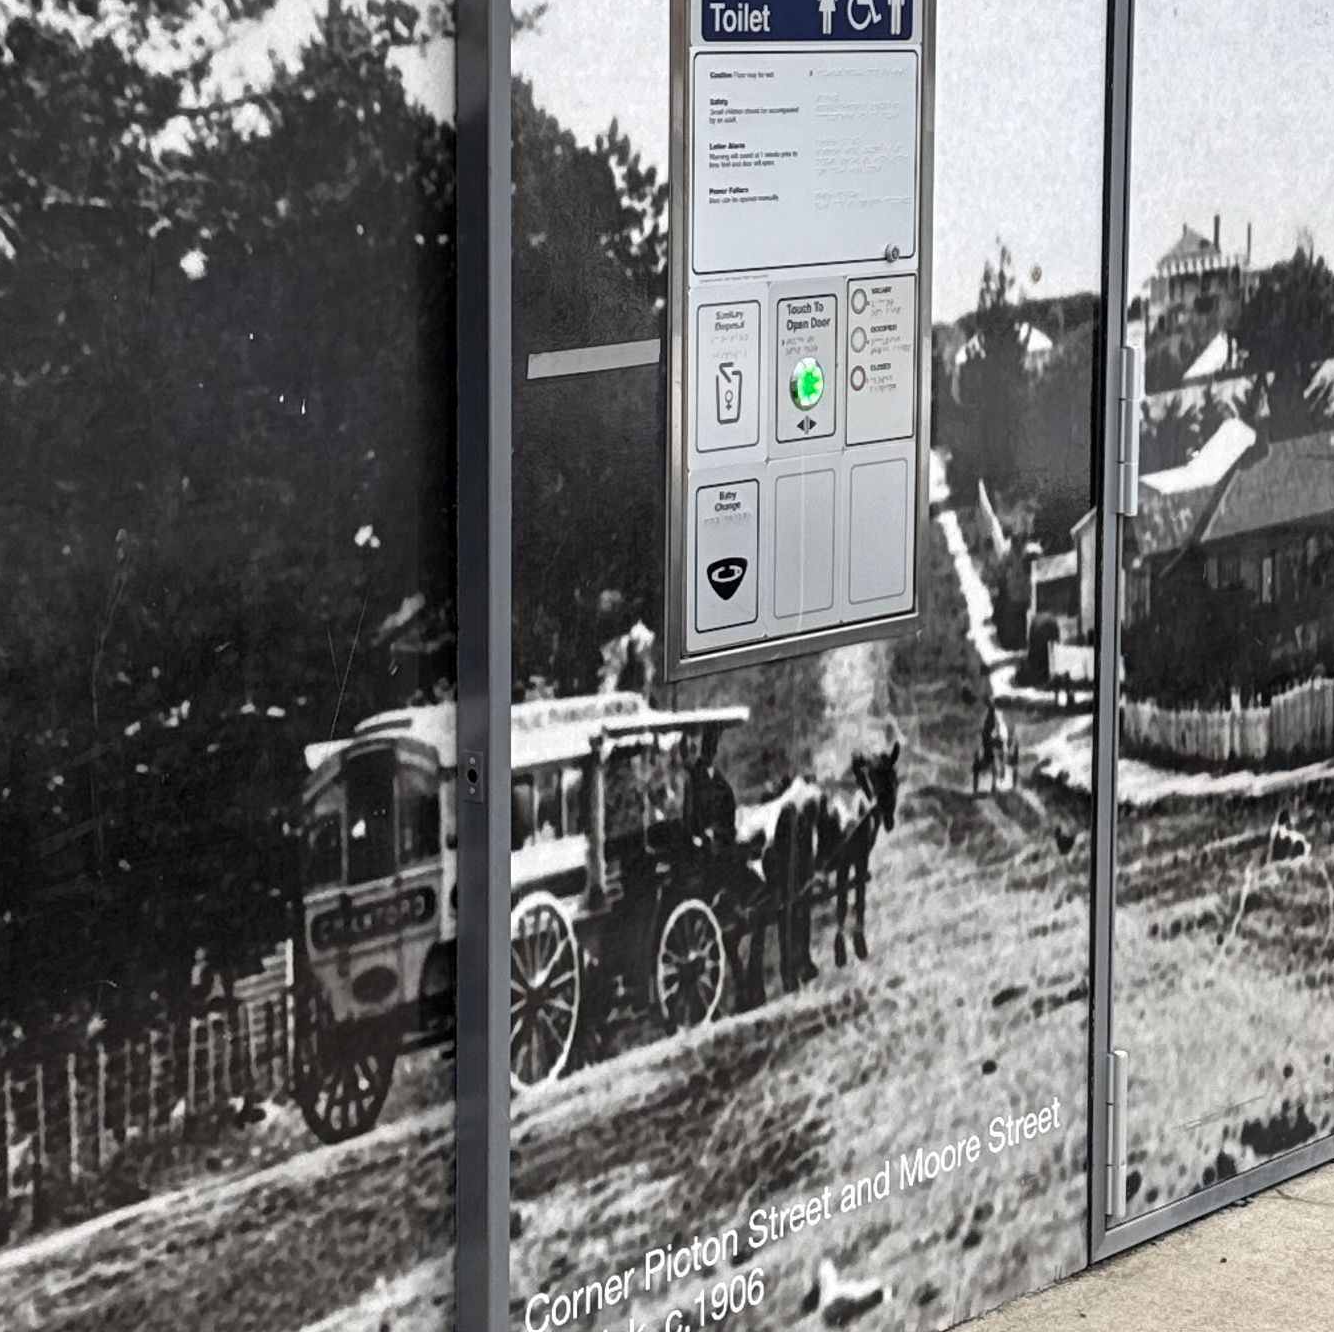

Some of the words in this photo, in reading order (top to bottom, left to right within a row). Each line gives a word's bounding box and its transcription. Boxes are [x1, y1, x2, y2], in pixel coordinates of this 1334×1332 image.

[709, 2, 771, 33] Toilet
[787, 303, 811, 315] Touch
[814, 301, 824, 312] To
[786, 319, 809, 333] Open
[810, 317, 831, 329] Door
[525, 1267, 635, 1332] Corner
[644, 1226, 738, 1291] Picton
[748, 1186, 831, 1256] Street
[840, 1161, 890, 1214] and
[899, 1133, 980, 1189] Moore
[988, 1097, 1061, 1151] Street
